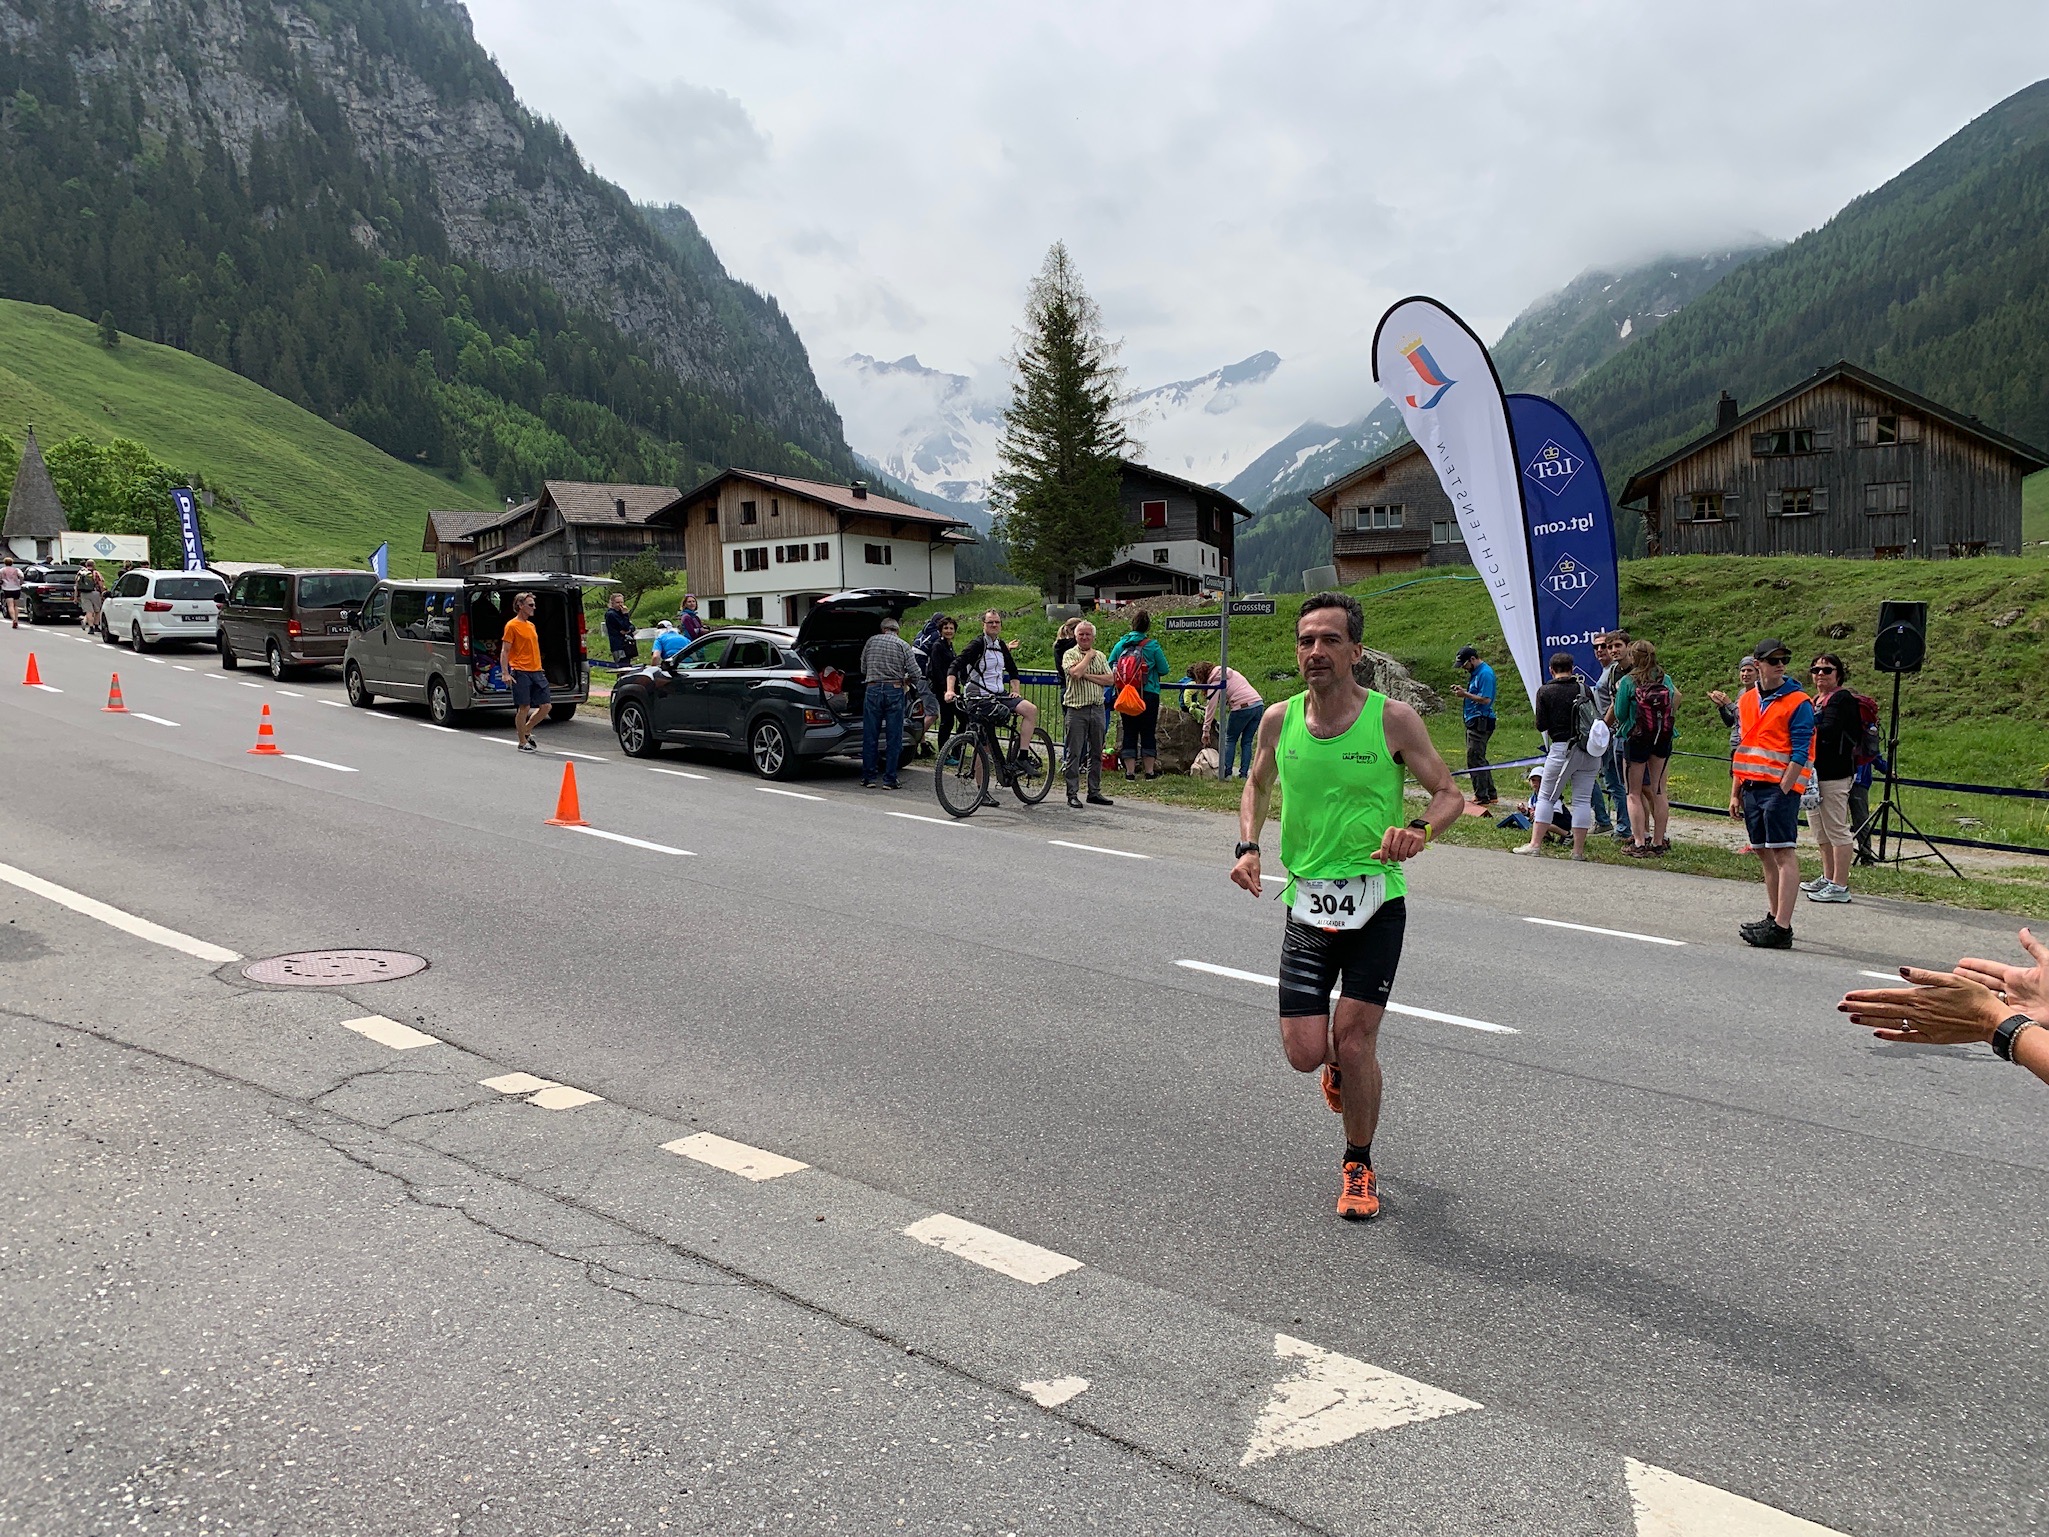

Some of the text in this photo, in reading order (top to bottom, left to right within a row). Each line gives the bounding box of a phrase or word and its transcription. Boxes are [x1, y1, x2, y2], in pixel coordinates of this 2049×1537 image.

[1232, 602, 1271, 613] Grosssteg
[1168, 619, 1219, 628] Malbunstrasse
[1310, 893, 1356, 916] 304
